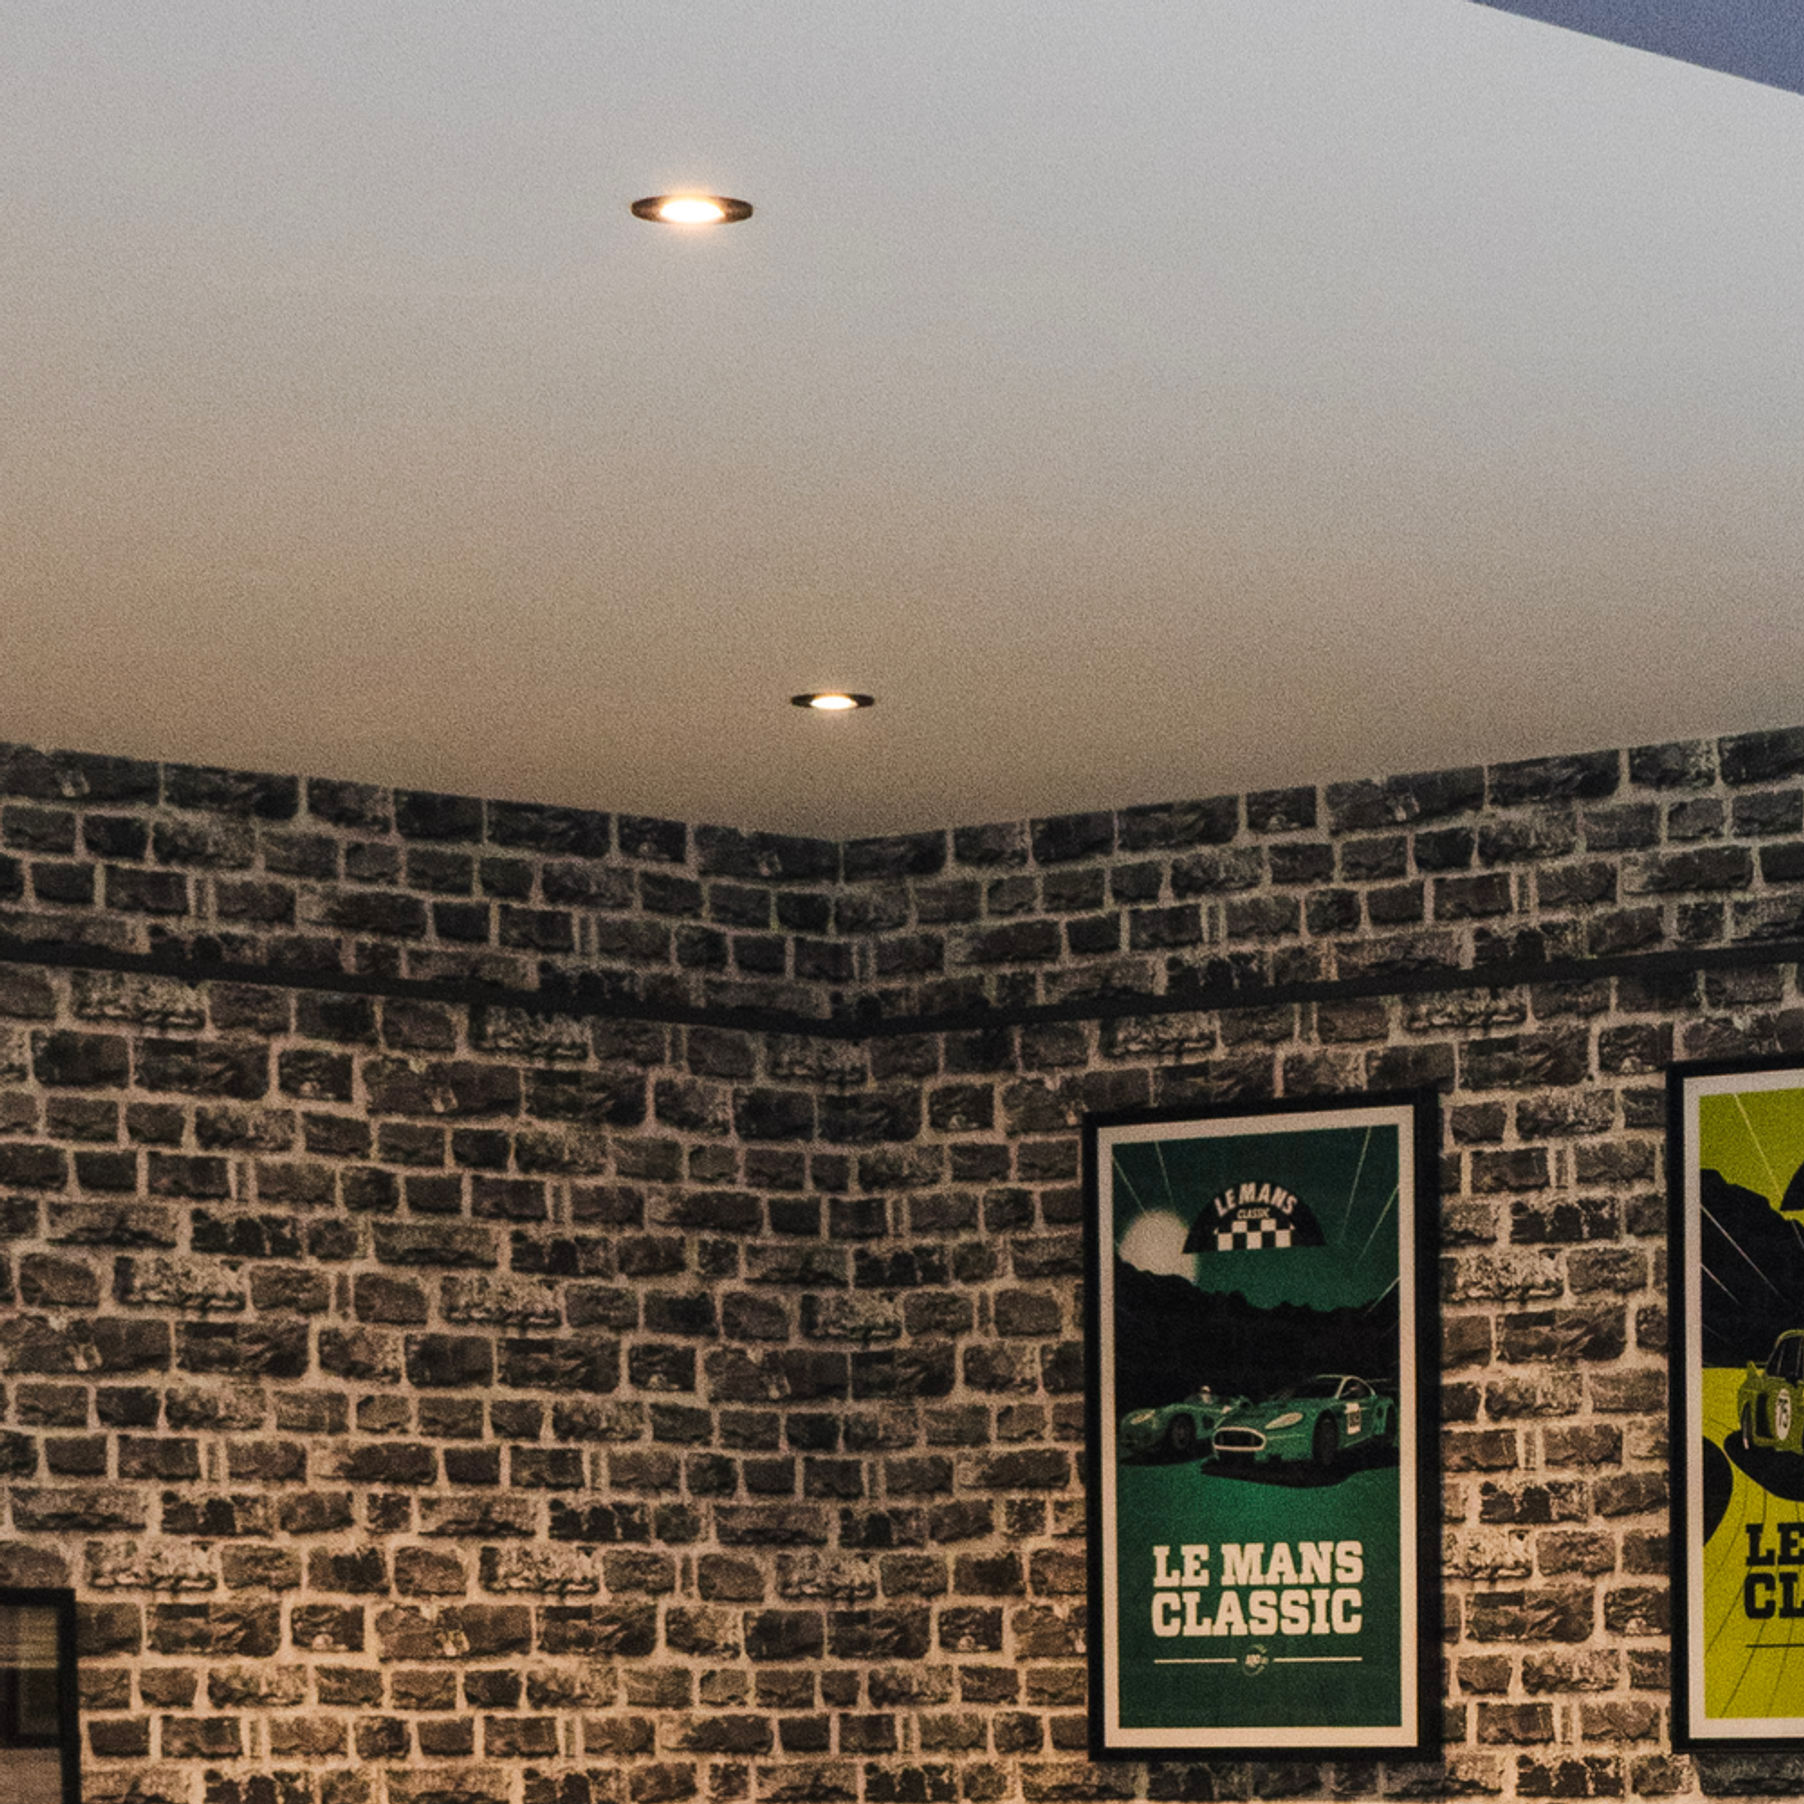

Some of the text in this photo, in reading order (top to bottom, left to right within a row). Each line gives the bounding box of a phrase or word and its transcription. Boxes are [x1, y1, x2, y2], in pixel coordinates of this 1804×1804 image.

[1213, 1181, 1298, 1217] LE MANS
[1153, 1540, 1364, 1588] LE MANS
[1151, 1588, 1363, 1637] CLASSIC
